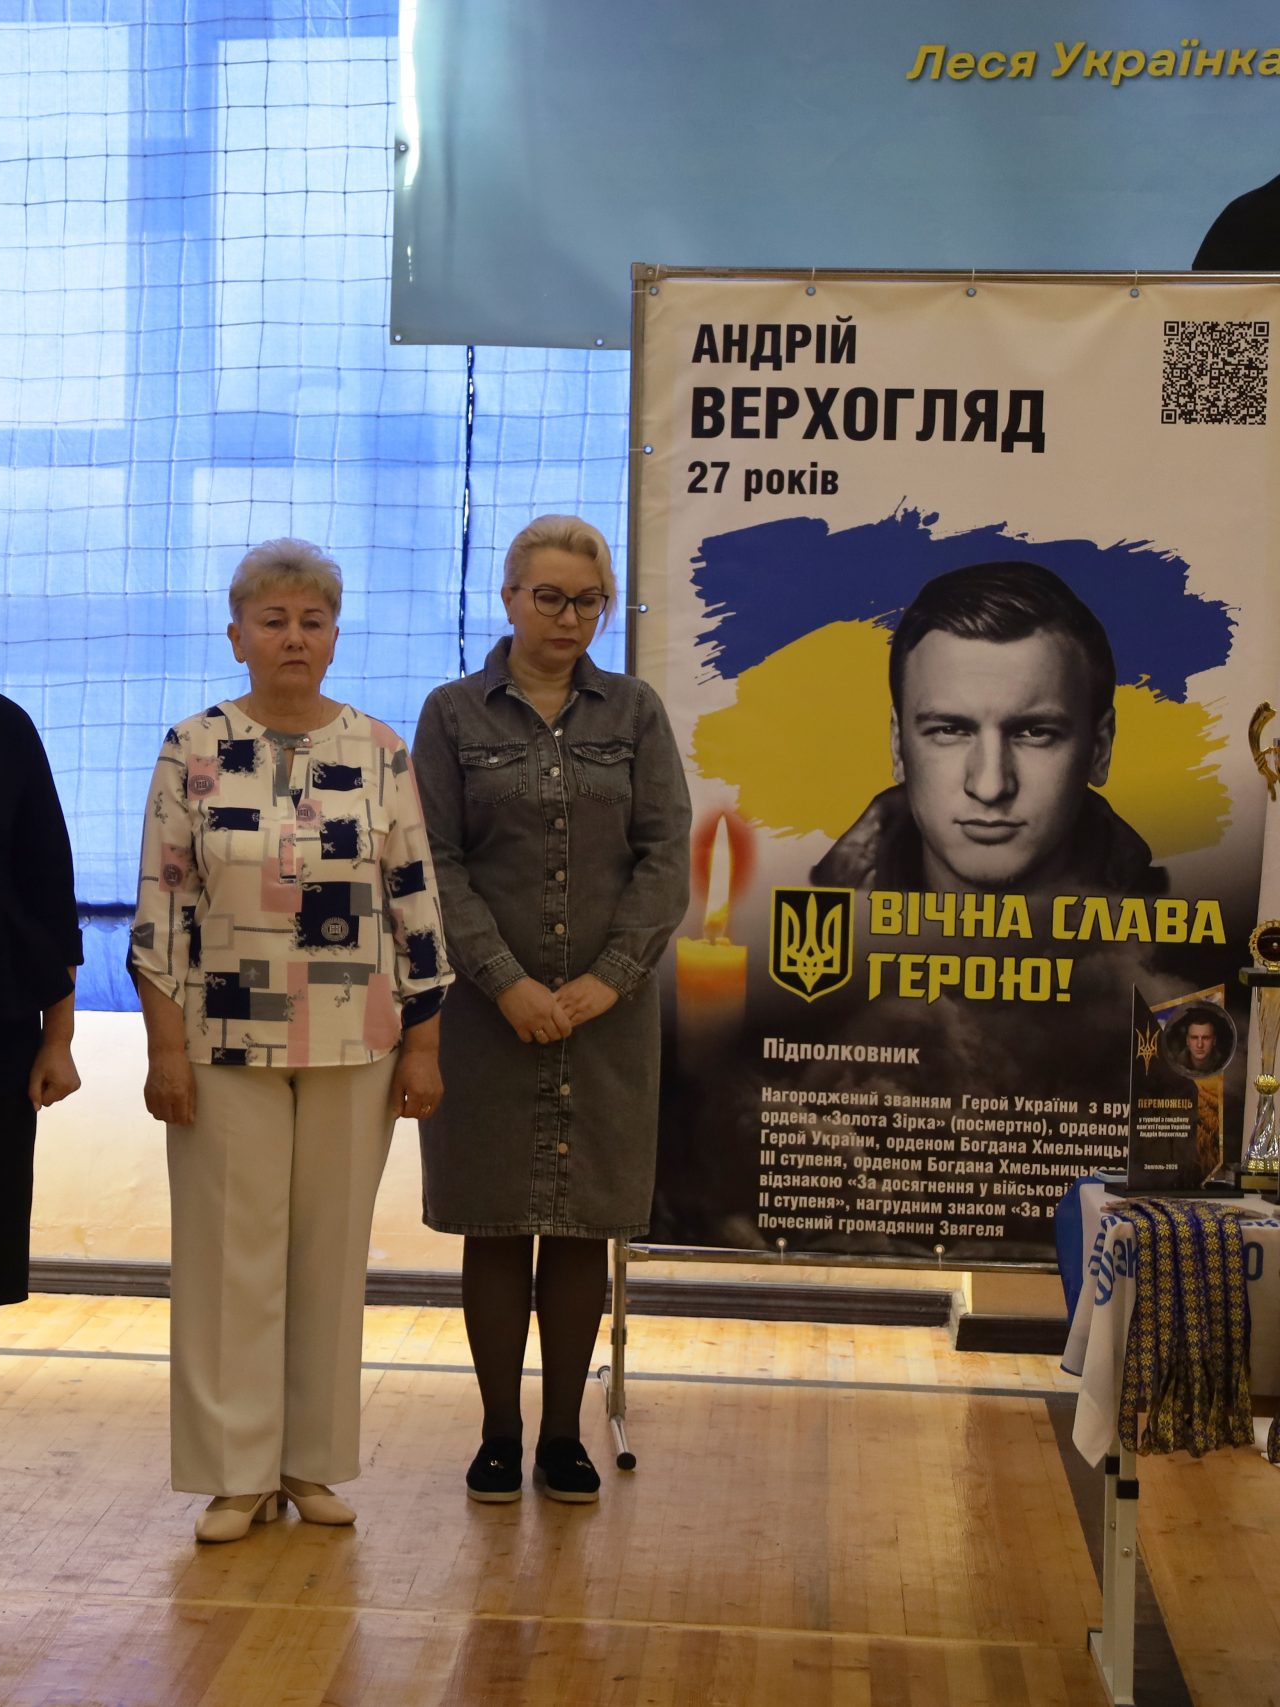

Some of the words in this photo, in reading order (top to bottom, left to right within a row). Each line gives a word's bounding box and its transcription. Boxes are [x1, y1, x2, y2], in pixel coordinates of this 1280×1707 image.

[905, 43, 1038, 80] Леся
[1051, 38, 1280, 87] Українка
[691, 315, 857, 371] АНДРІЙ
[691, 386, 1045, 454] ВЕРХОГЛЯД
[687, 460, 730, 494] 27
[744, 461, 839, 502] років
[867, 890, 1033, 939] ВІЧНА
[1051, 895, 1227, 945] СЛАВА
[866, 952, 1074, 1005] ГЕРОЮ!
[763, 1037, 920, 1065] Підполковник
[761, 1086, 879, 1106] Нагороджений
[883, 1096, 952, 1110] званням
[962, 1094, 1009, 1113] Герой
[1014, 1096, 1078, 1115] України
[1088, 1102, 1098, 1114] з
[1137, 1098, 1193, 1110] ПЕРЕМОЖЕЦЬ
[761, 1111, 817, 1126] ордена
[822, 1110, 887, 1128] «Золота
[892, 1113, 946, 1131] Зірка»
[951, 1115, 1053, 1136] (посмертно),
[1059, 1122, 1129, 1137] орденом
[760, 1129, 806, 1148] Герой
[812, 1130, 880, 1149] України,
[886, 1137, 955, 1152] орденом
[960, 1136, 1027, 1155] Богдана
[780, 1152, 848, 1170] ступеня,
[853, 1156, 922, 1171] орденом
[927, 1157, 994, 1175] Богдана
[759, 1171, 843, 1188] відзнакою
[847, 1174, 877, 1190] «За
[881, 1178, 975, 1194] досягнення
[979, 1183, 989, 1198] у
[774, 1194, 850, 1211] ступеня»,
[856, 1198, 943, 1214] нагрудним
[948, 1202, 1006, 1216] знаком
[1011, 1202, 1040, 1217] «За
[758, 1213, 833, 1230] Почесний
[838, 1219, 934, 1235] громадянин
[939, 1220, 1005, 1237] Звягеля
